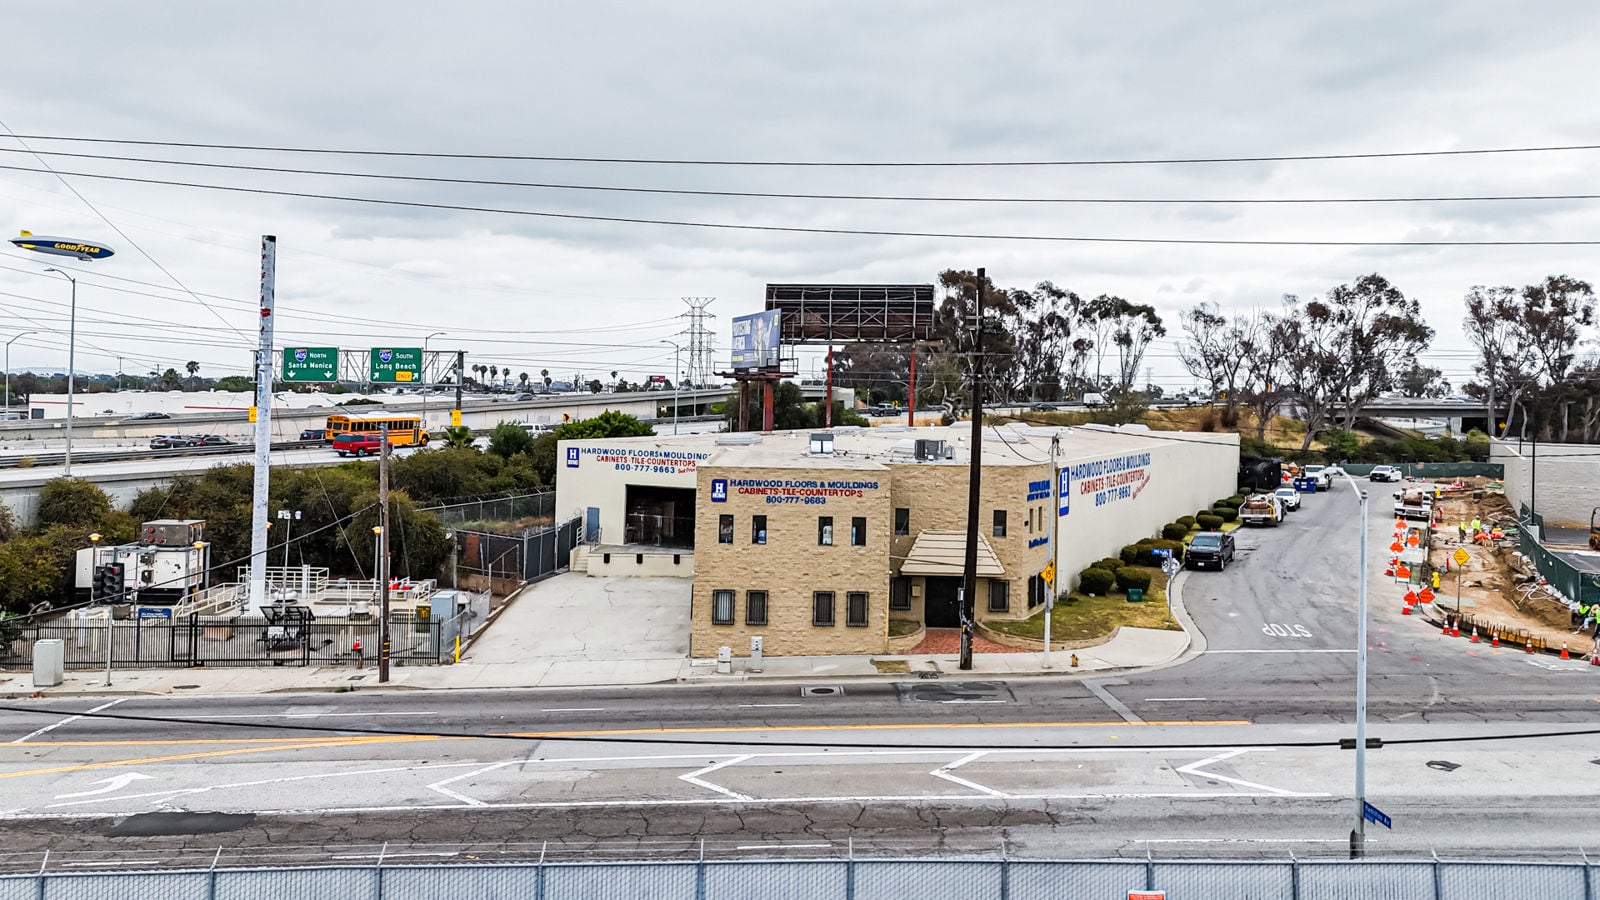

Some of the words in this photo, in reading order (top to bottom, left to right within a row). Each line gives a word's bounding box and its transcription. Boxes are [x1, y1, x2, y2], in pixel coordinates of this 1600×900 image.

[54, 243, 100, 253] GOODYEAR
[288, 361, 307, 369] Santa
[375, 362, 392, 371] Long
[395, 362, 417, 370] Beach
[581, 447, 627, 456] HARDWOOD
[628, 449, 659, 458] FLOORS
[615, 463, 676, 474] 800-777-9663
[1071, 460, 1103, 481] HARDWOOD
[1103, 456, 1122, 475] FLOORS
[1126, 452, 1151, 470] MOULDINGS
[729, 479, 783, 488] HARDWOOD
[785, 480, 818, 489] FLOORS
[827, 481, 879, 490] MOULDINGS
[1095, 485, 1132, 507] 800-777-9663
[1262, 623, 1313, 638] STOP
